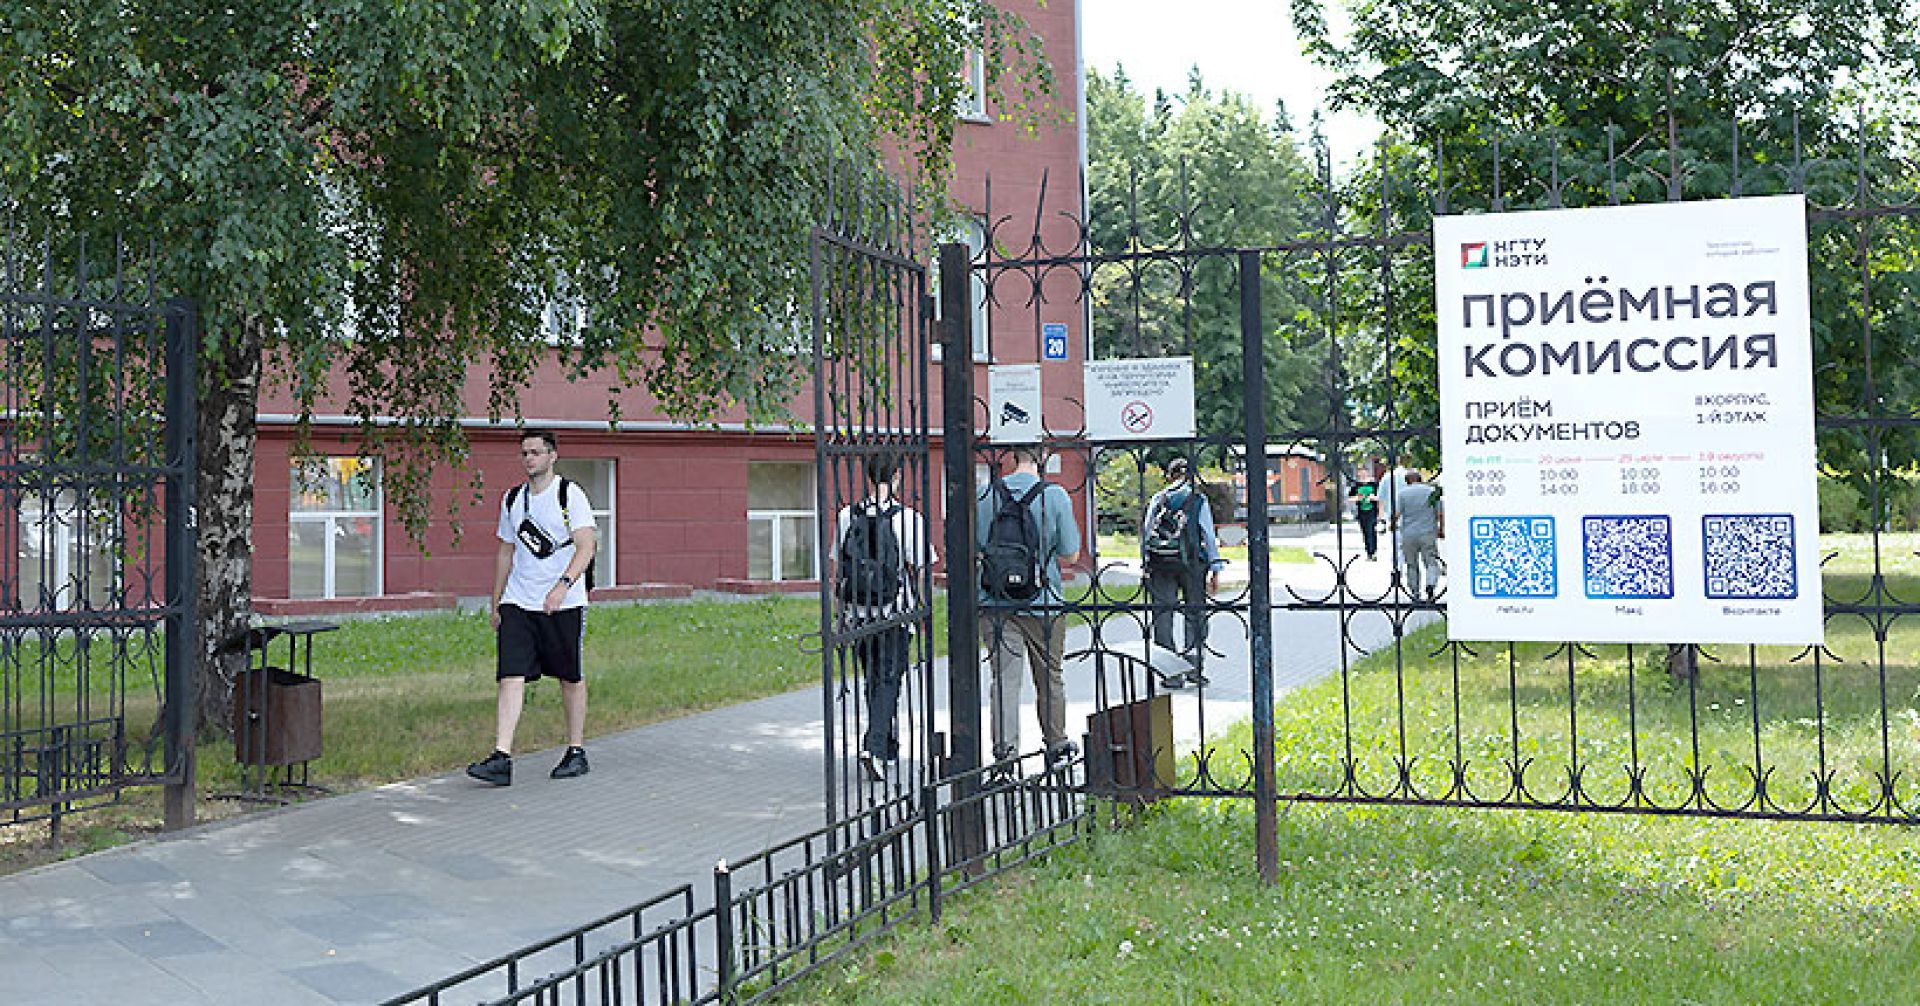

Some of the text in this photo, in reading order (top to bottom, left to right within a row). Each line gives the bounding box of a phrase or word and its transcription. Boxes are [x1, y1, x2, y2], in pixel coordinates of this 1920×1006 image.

[1494, 238, 1547, 253] НГТУ
[1495, 254, 1549, 268] НЭТИ
[1462, 275, 1778, 339] приёмная
[1048, 338, 1064, 356] 20
[1464, 333, 1778, 378] комиссия
[1465, 396, 1553, 419] ПРИЁМ
[1465, 421, 1641, 445] ДОКУМЕНТОВ
